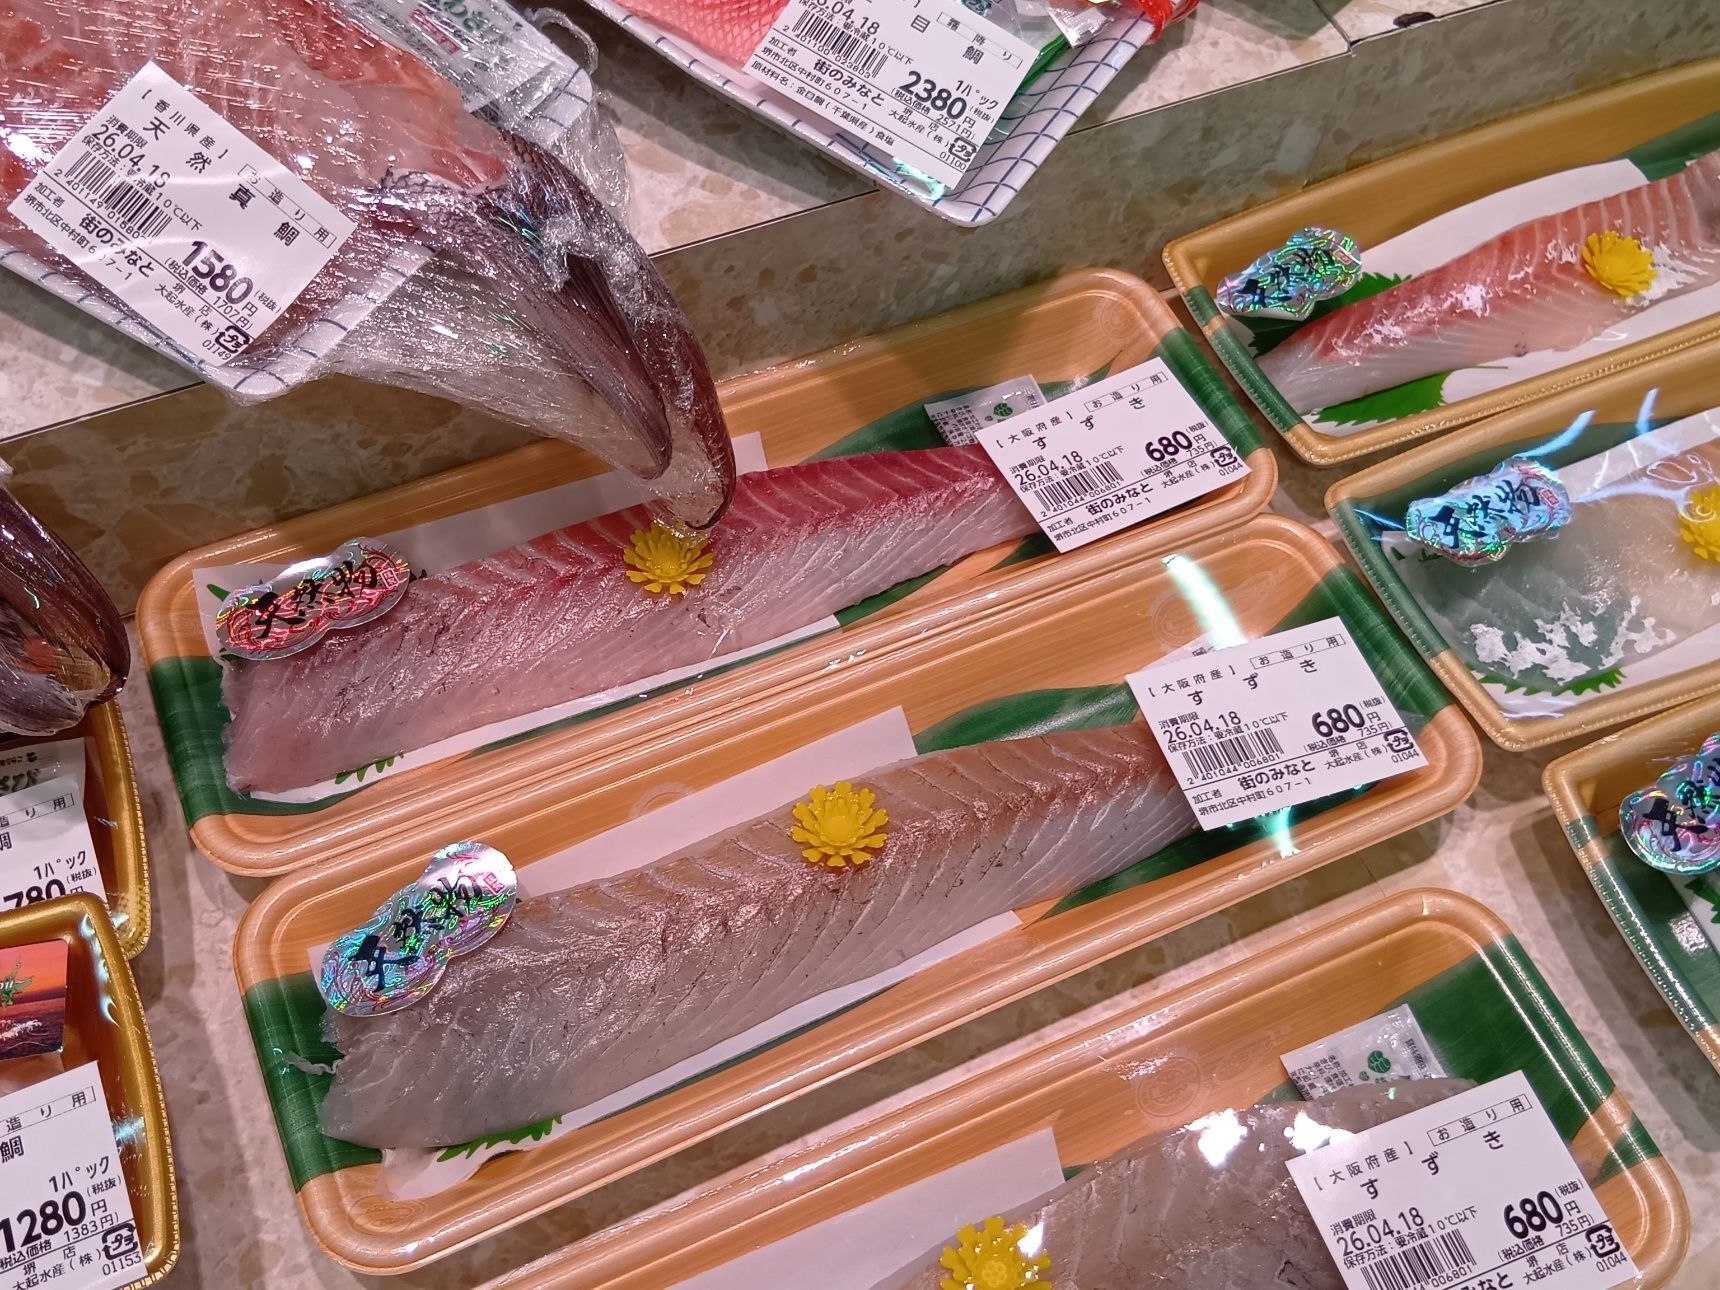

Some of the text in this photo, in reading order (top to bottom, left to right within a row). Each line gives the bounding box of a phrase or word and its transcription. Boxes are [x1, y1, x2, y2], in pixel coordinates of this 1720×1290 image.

[946, 17, 1013, 61] 霜降り
[768, 36, 798, 57] 加工者
[813, 58, 885, 107] 街のみなと
[105, 114, 148, 150] 消費期限
[33, 181, 66, 209] 加工者
[142, 116, 300, 247] 天然真鯛
[1031, 396, 1146, 451] すずき
[1010, 455, 1046, 475] 消費期限
[1014, 450, 1083, 487] 26.04.18
[1218, 461, 1244, 477] 01044
[1046, 516, 1074, 533] 加工者
[1085, 483, 1154, 516] 街のみなと
[1186, 659, 1318, 706] すずき
[1158, 711, 1200, 730] 消費期限
[1162, 710, 1242, 745] 26.04.18
[1390, 748, 1420, 764] 01044
[1191, 788, 1223, 805] 加工者
[1237, 759, 1316, 791] 街のみなと
[1436, 1098, 1525, 1141] お造り用
[1359, 1130, 1504, 1200] すずき
[1330, 1208, 1377, 1236] 消費期限
[1336, 1206, 1425, 1257] 26.04.18
[101, 1250, 142, 1276] 01153
[1595, 1251, 1628, 1273] 01044
